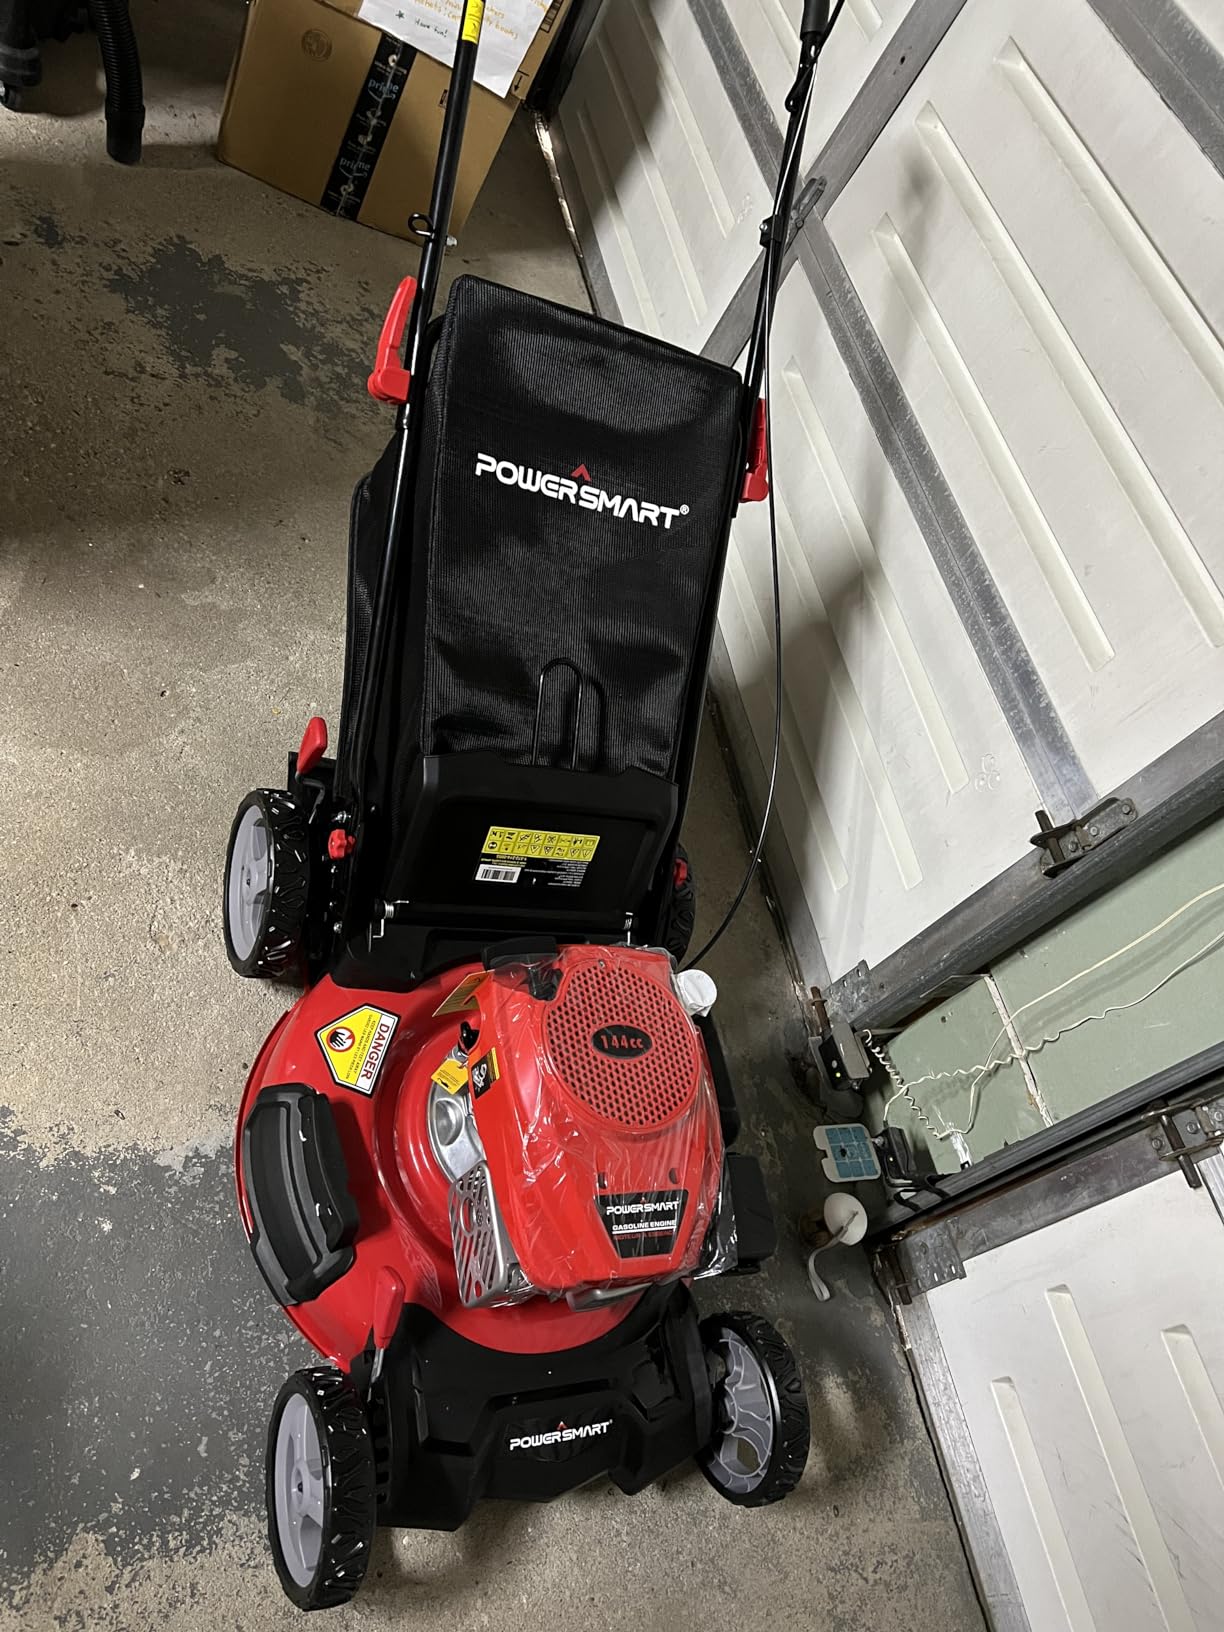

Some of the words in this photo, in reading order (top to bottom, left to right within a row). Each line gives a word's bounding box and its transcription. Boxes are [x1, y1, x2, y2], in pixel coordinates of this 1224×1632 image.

[600, 1034, 644, 1049] 144cc
[361, 1023, 390, 1080] DANGER
[606, 1201, 680, 1216] POWERSMART
[612, 1222, 649, 1231] GASOLINE
[650, 1219, 676, 1228] ENGINE
[509, 1421, 610, 1451] POWERSMART
